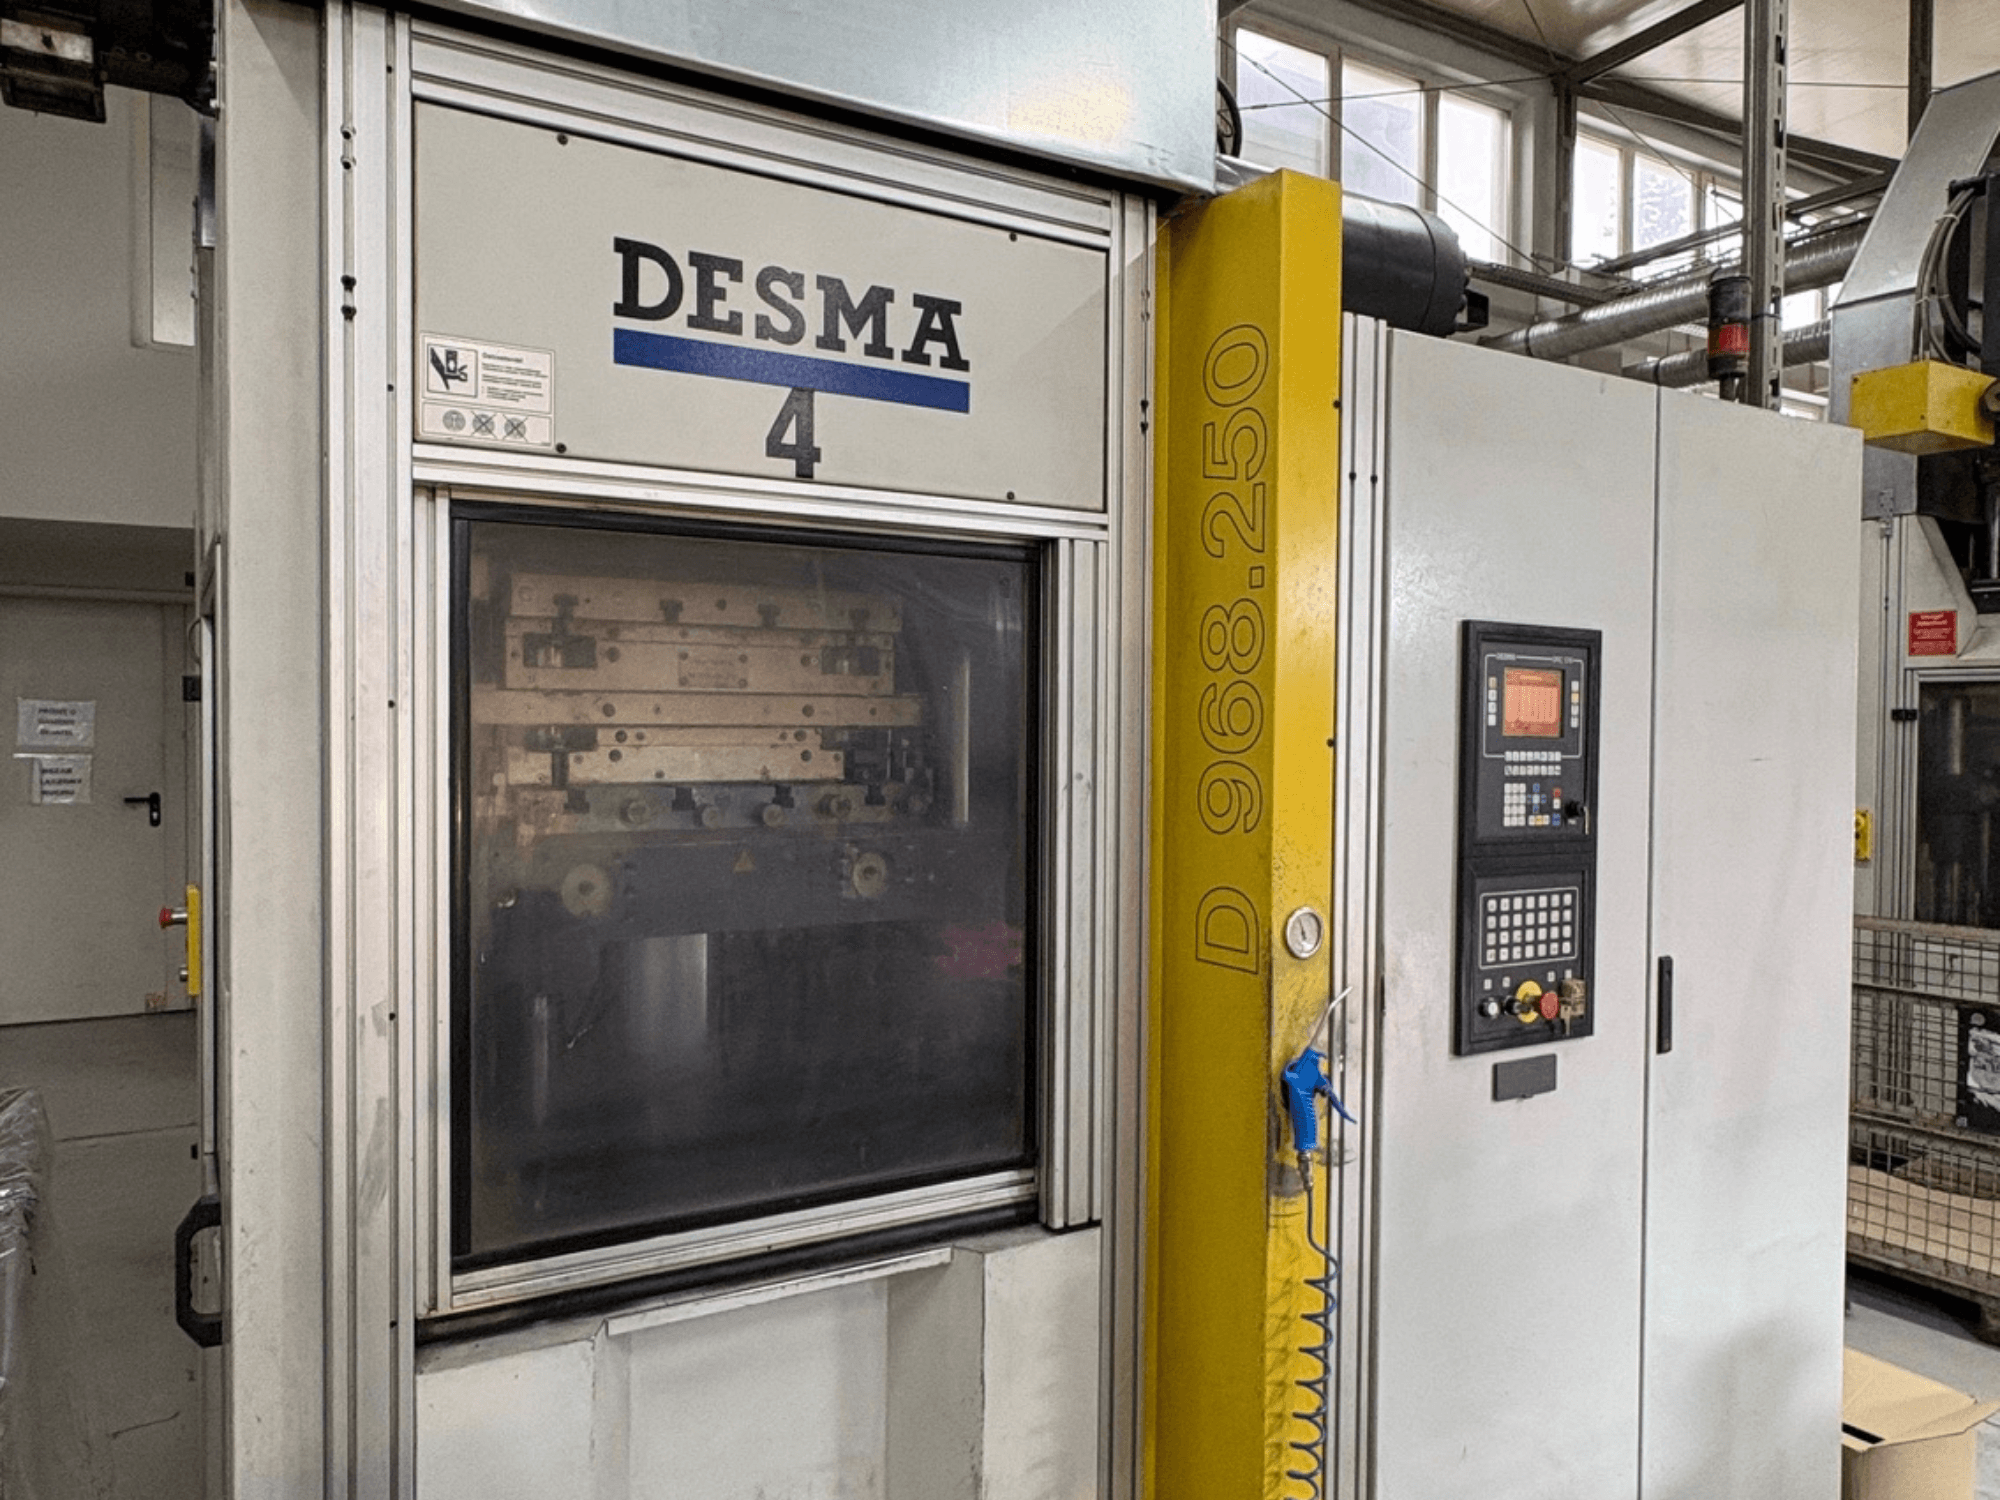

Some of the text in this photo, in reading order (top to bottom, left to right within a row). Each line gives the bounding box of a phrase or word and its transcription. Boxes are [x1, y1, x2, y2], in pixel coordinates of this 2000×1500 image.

[613, 236, 970, 372] DESMA
[765, 388, 821, 478] 4
[1195, 323, 1269, 974] D 968.250
